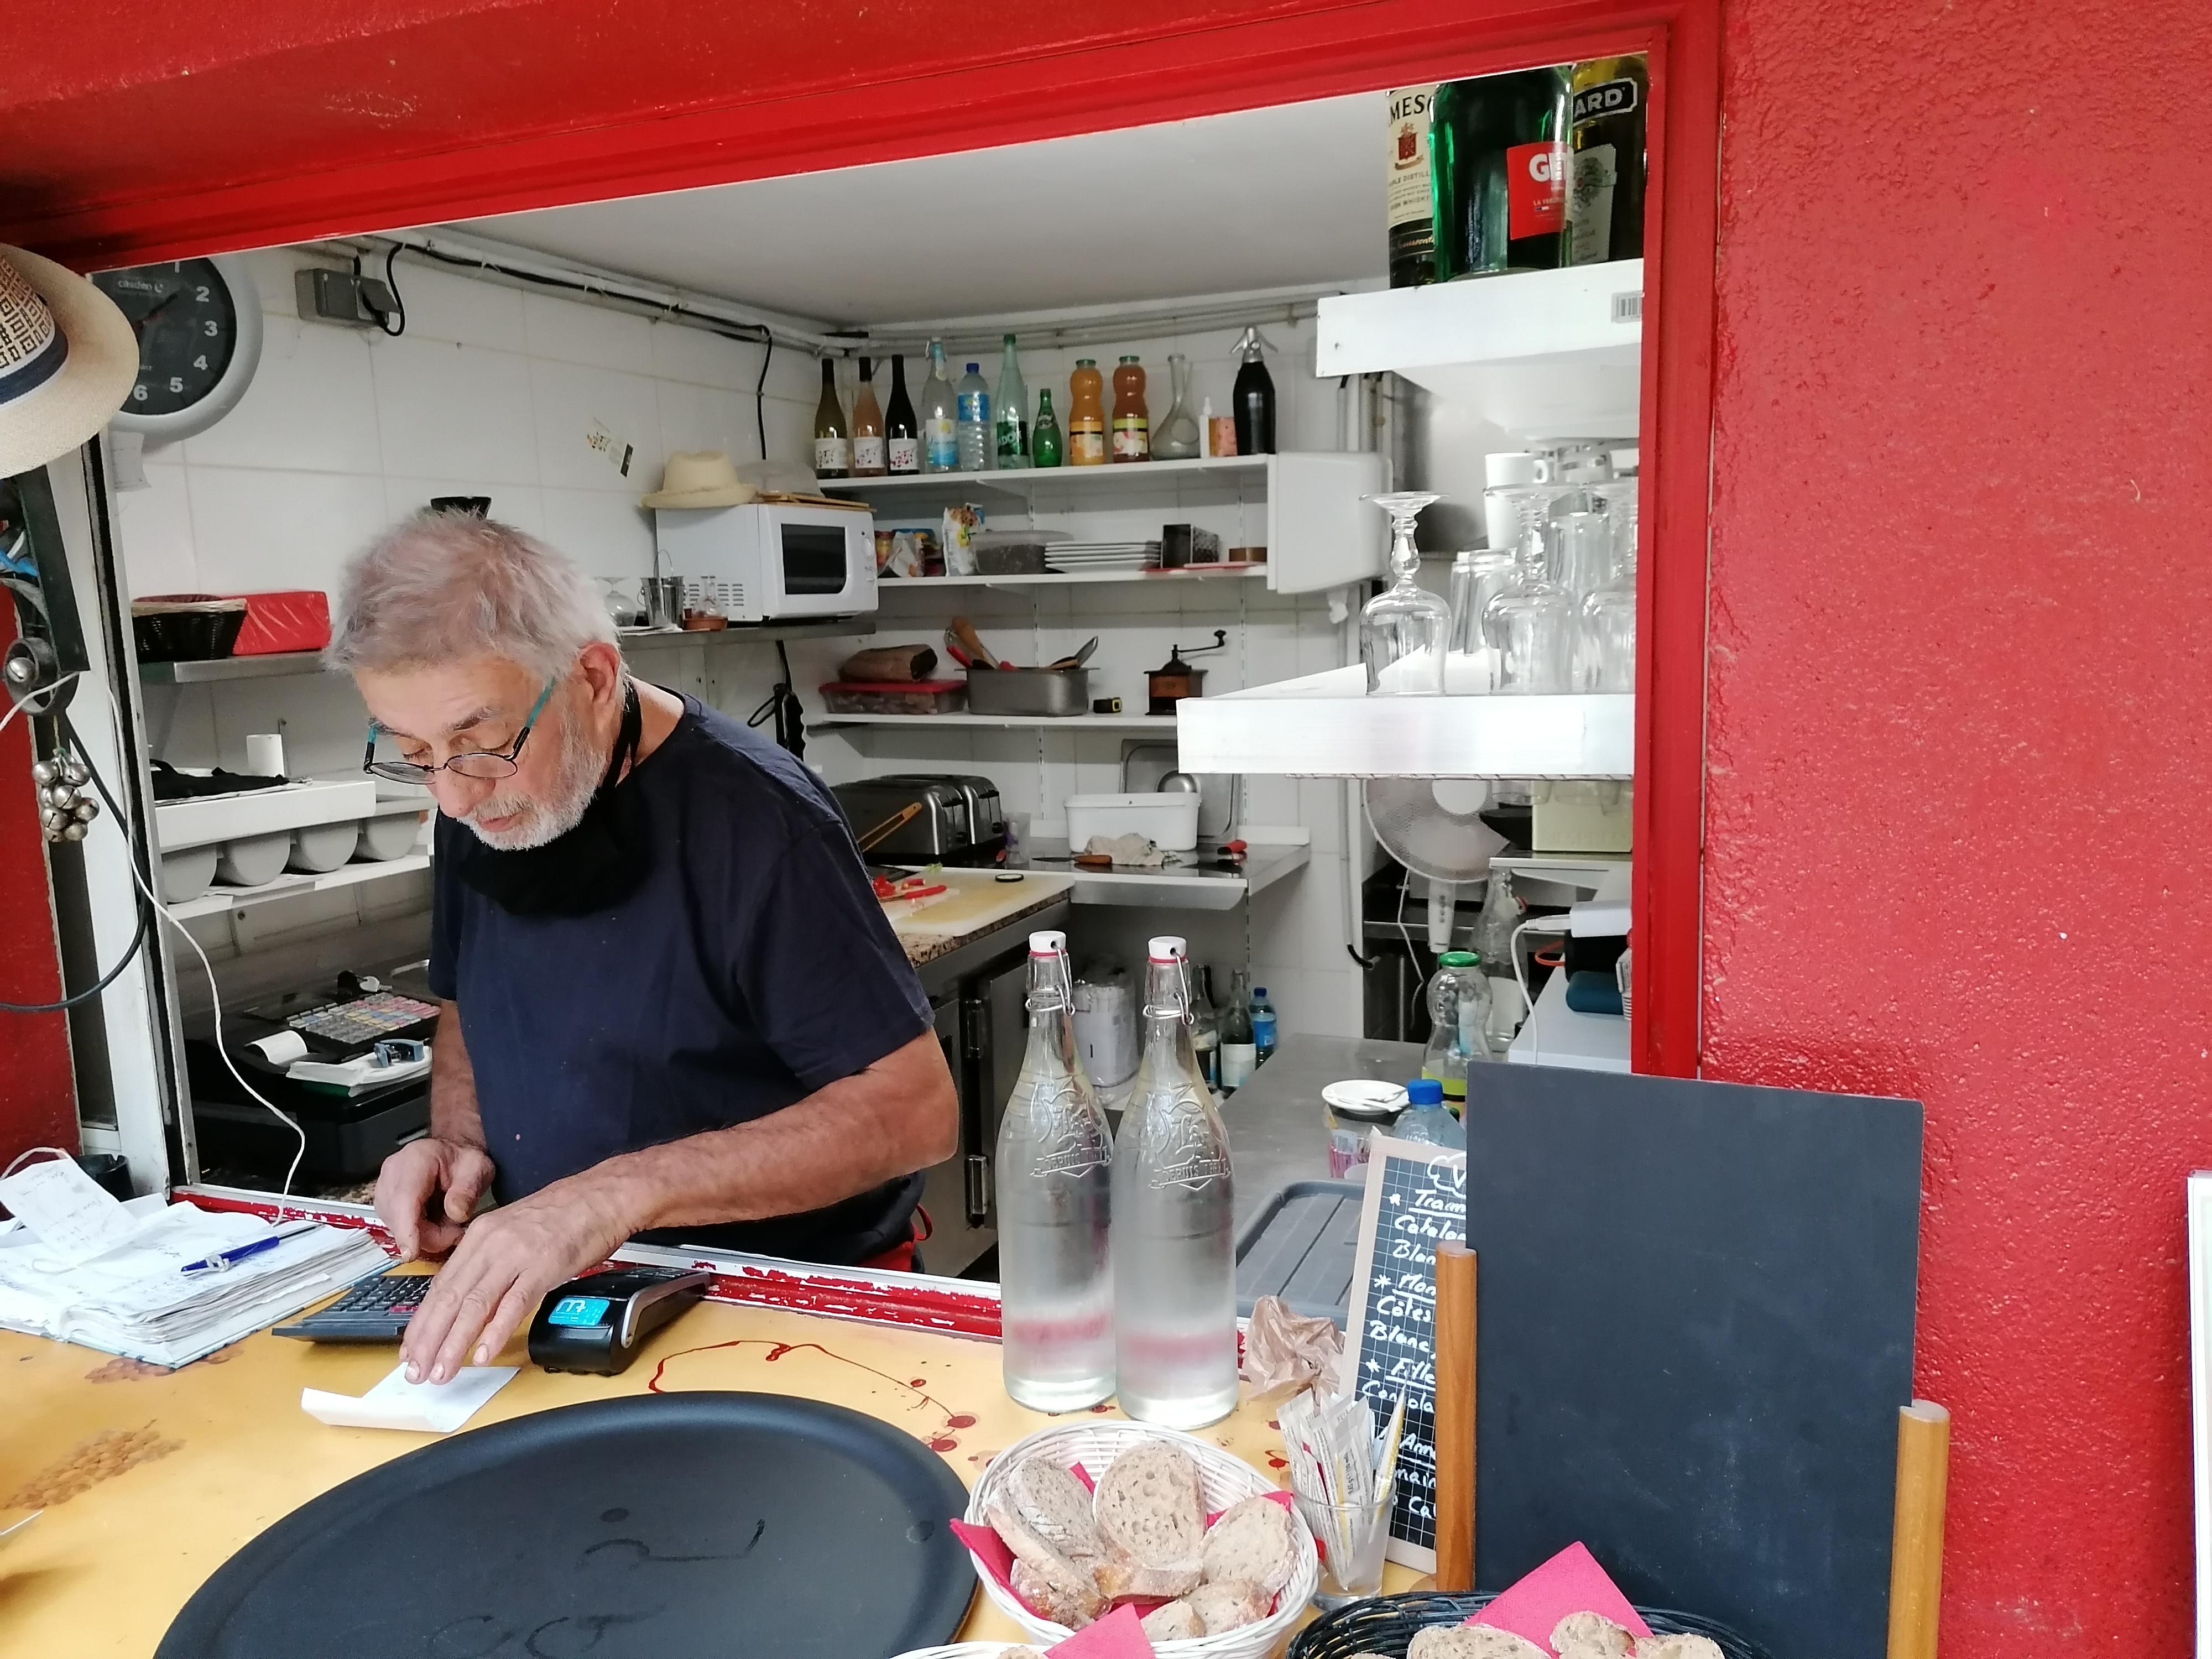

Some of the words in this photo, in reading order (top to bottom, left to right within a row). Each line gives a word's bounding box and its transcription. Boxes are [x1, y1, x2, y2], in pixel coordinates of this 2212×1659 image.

[1574, 88, 1623, 118] ARD
[196, 285, 210, 302] 2
[204, 320, 218, 337] 3
[193, 354, 208, 371] 4
[133, 384, 148, 401] 6
[169, 377, 184, 393] 5
